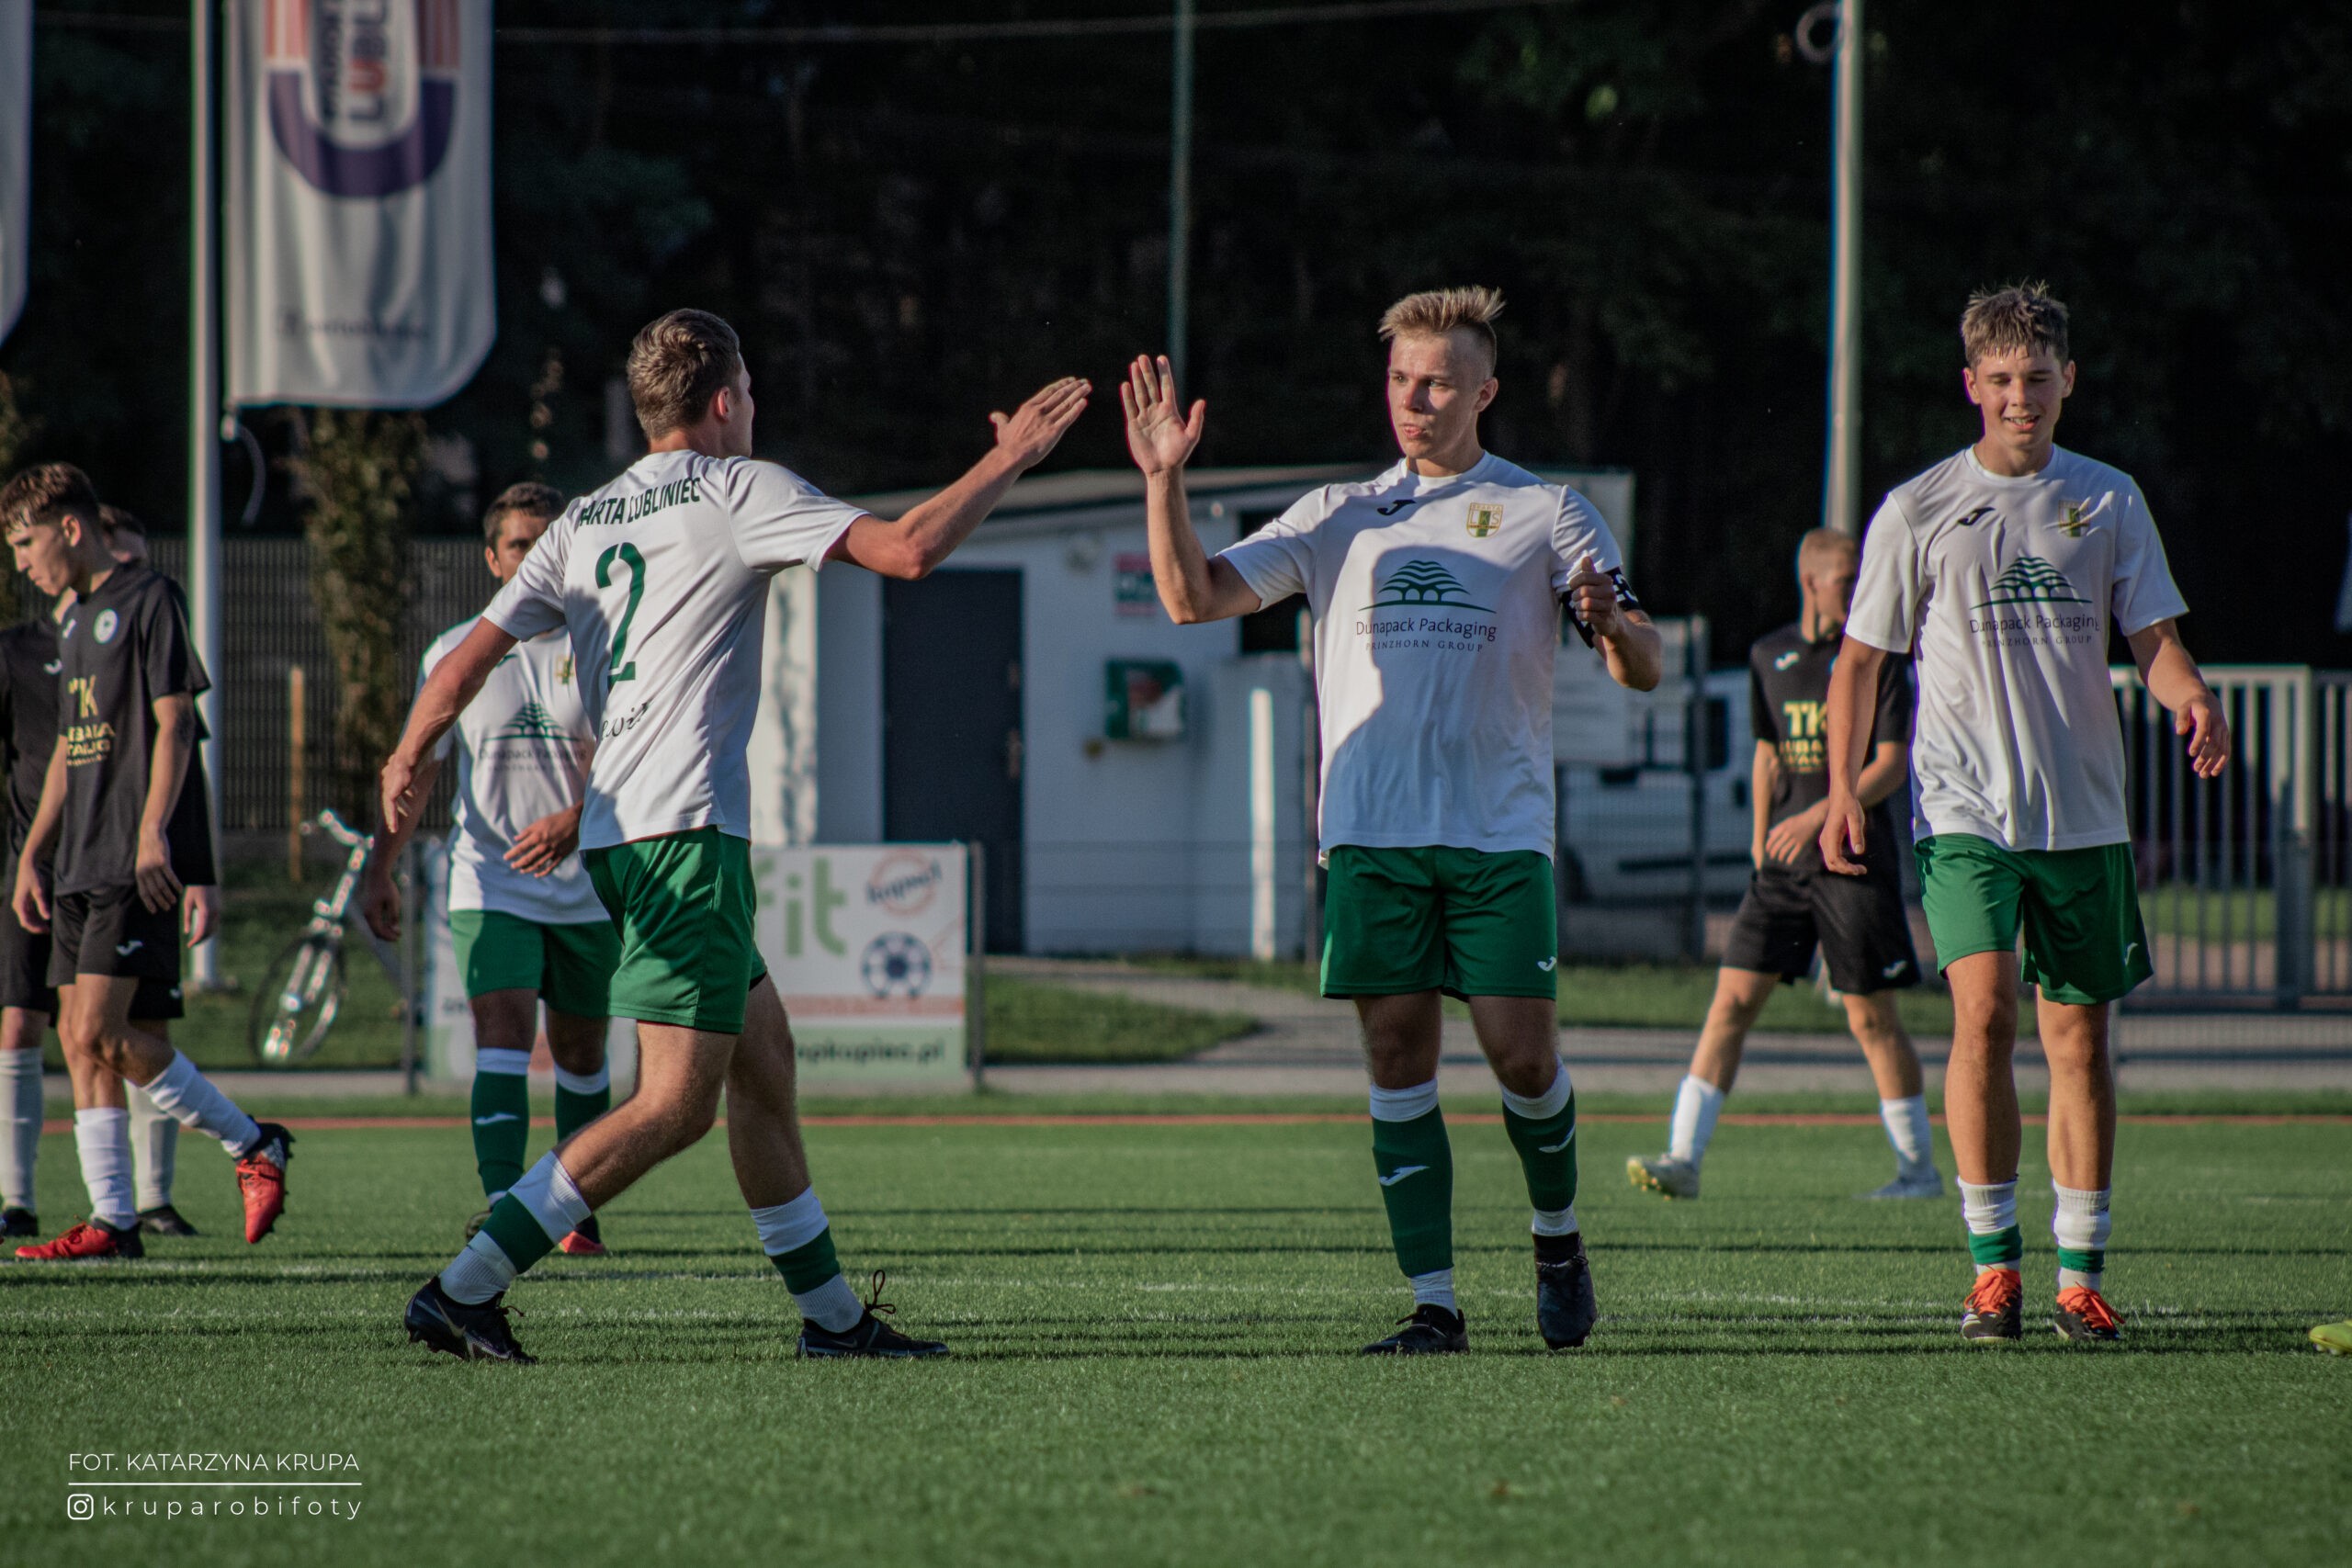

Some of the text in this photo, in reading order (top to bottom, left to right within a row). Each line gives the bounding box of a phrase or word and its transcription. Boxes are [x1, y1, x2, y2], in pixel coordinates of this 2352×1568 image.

[580, 477, 700, 526] ARTA LUBLINIEC
[595, 542, 646, 690] 2
[1969, 616, 2030, 634] Dunapack
[1356, 617, 1497, 642] Dunapack Packaging
[1365, 639, 1484, 652] PRINZHORN GROUP
